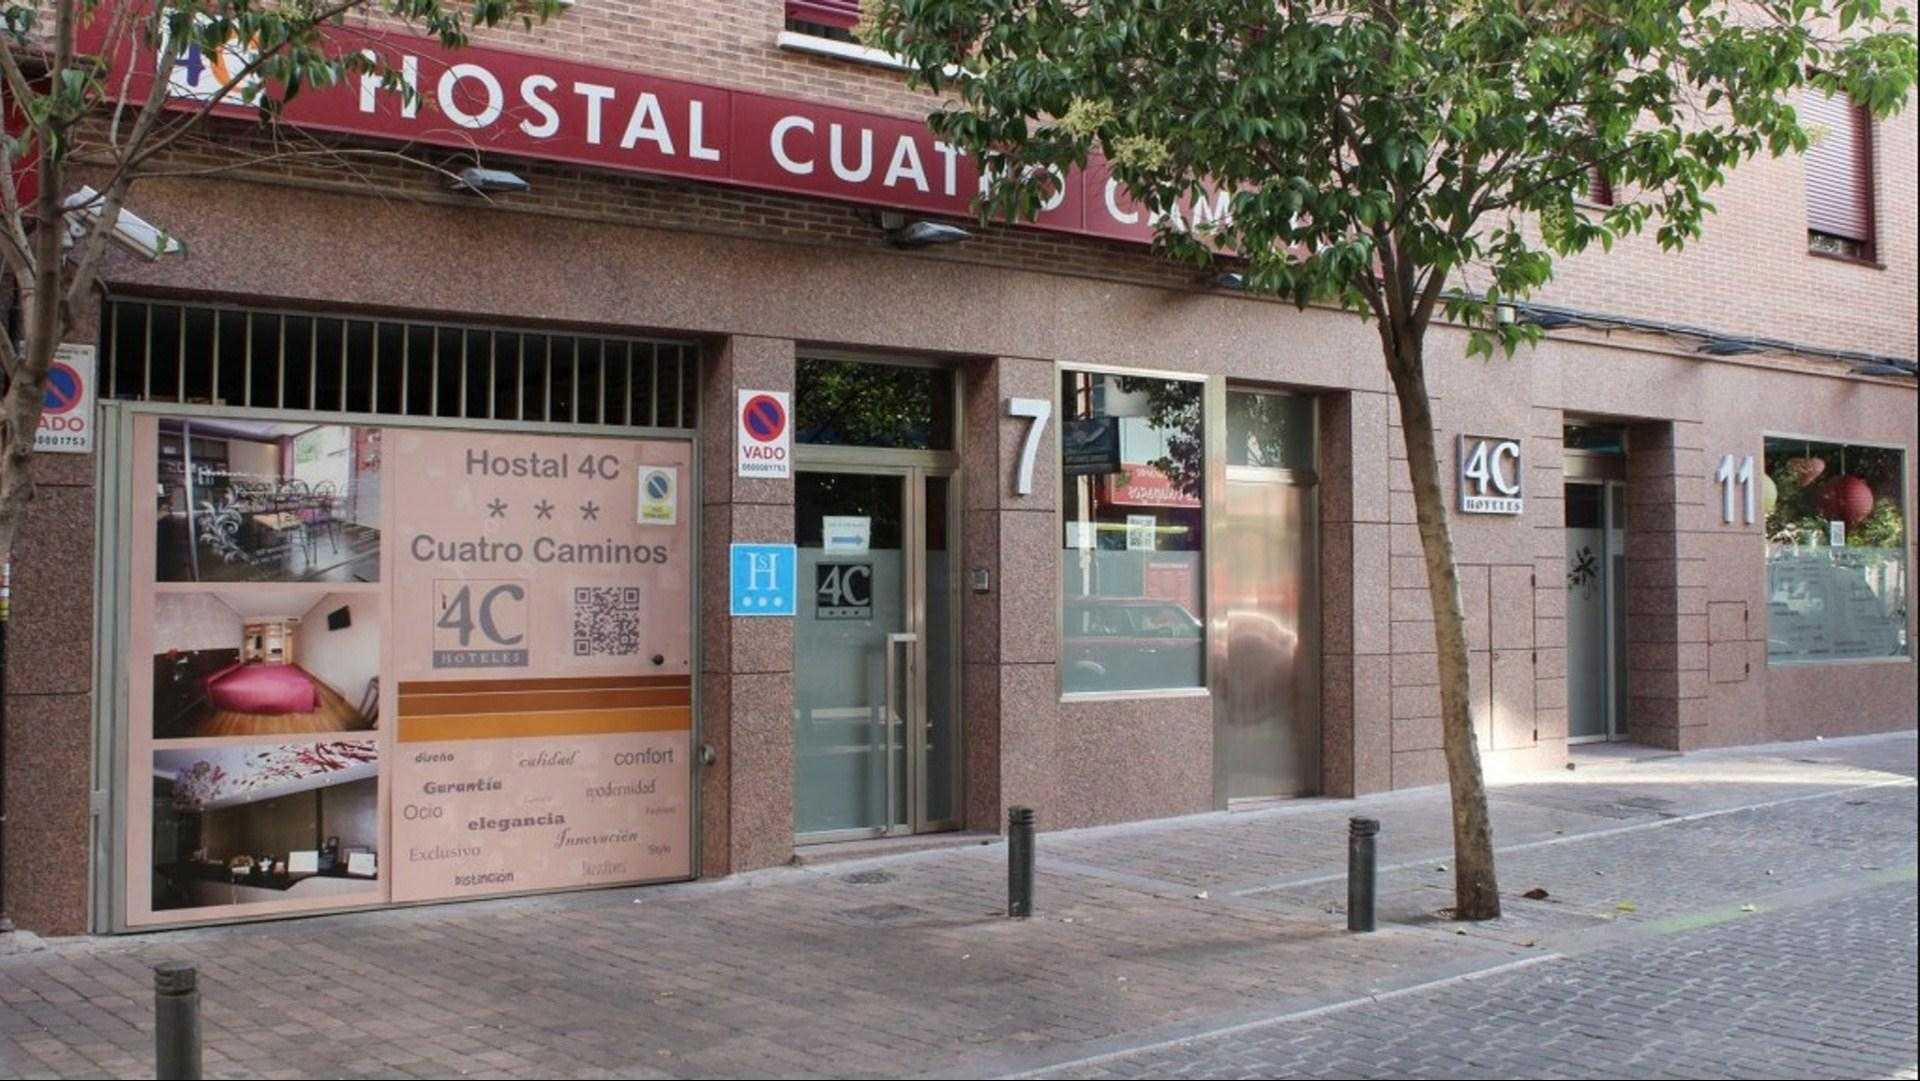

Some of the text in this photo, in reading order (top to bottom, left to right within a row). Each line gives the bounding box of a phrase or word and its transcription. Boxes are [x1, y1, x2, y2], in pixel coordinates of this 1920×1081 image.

[359, 49, 721, 162] HOSTAL
[36, 416, 85, 433] ADO
[743, 445, 786, 460] VADO
[1009, 397, 1051, 494] 7
[466, 449, 620, 480] Hostal 4C
[1465, 440, 1521, 495] 4C
[1717, 453, 1755, 523] 11
[411, 534, 669, 565] Cuatro Caminos
[819, 565, 871, 606] 4C
[437, 584, 525, 647] 4C
[441, 651, 522, 665] HOTELES
[518, 750, 579, 769] calidad
[614, 748, 674, 766] confort
[423, 777, 502, 795] Garantía
[585, 778, 657, 800] modernidad
[404, 804, 443, 820] Ocio
[468, 812, 566, 831] elegancia
[408, 845, 481, 861] Exclusivo
